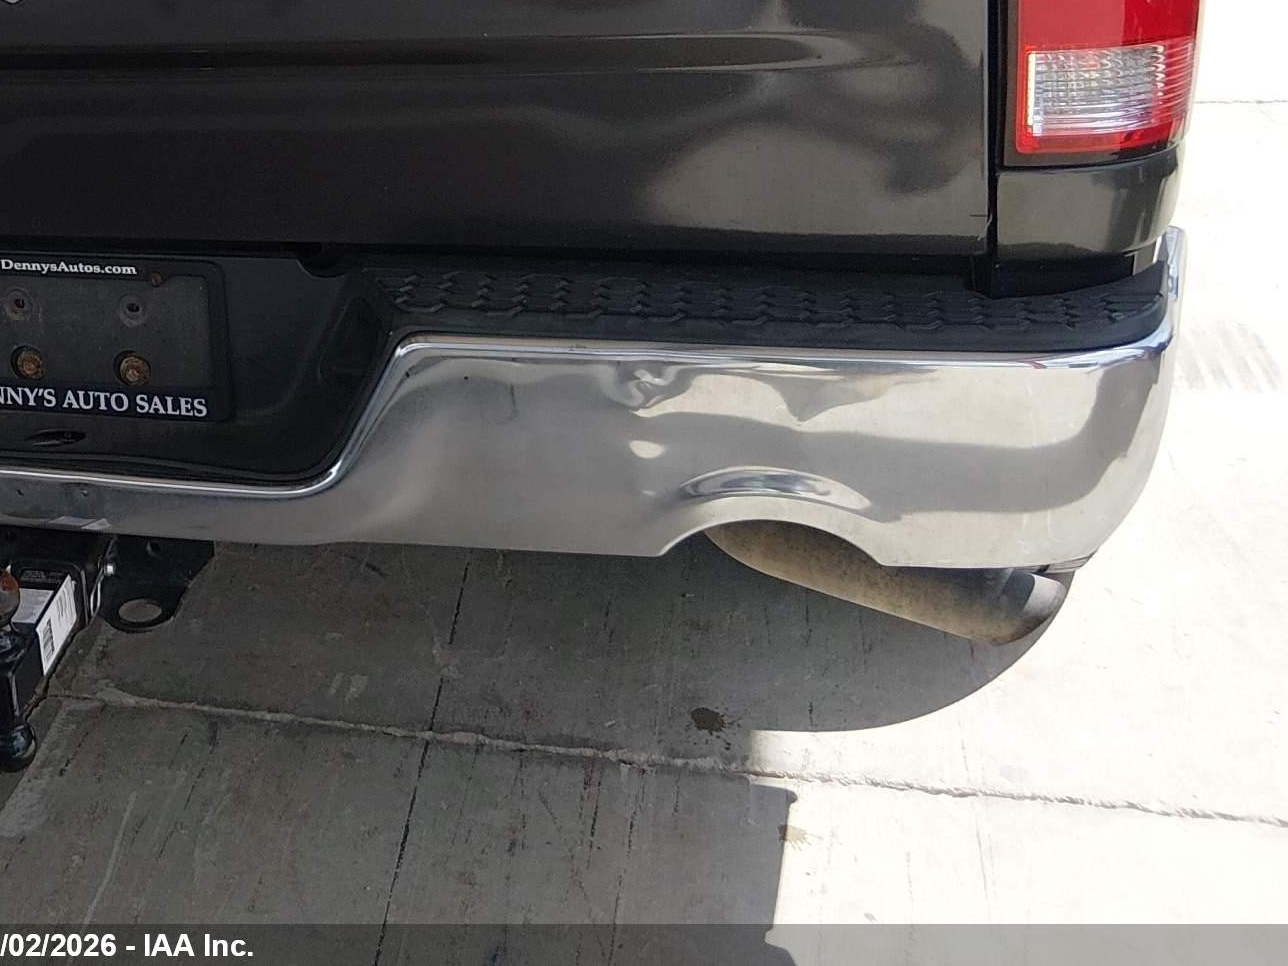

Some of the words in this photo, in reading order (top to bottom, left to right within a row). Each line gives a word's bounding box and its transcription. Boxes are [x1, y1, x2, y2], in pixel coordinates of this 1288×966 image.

[0, 259, 137, 275] DennysAutos.com
[62, 389, 129, 412] AUTO
[135, 394, 208, 418] SALES
